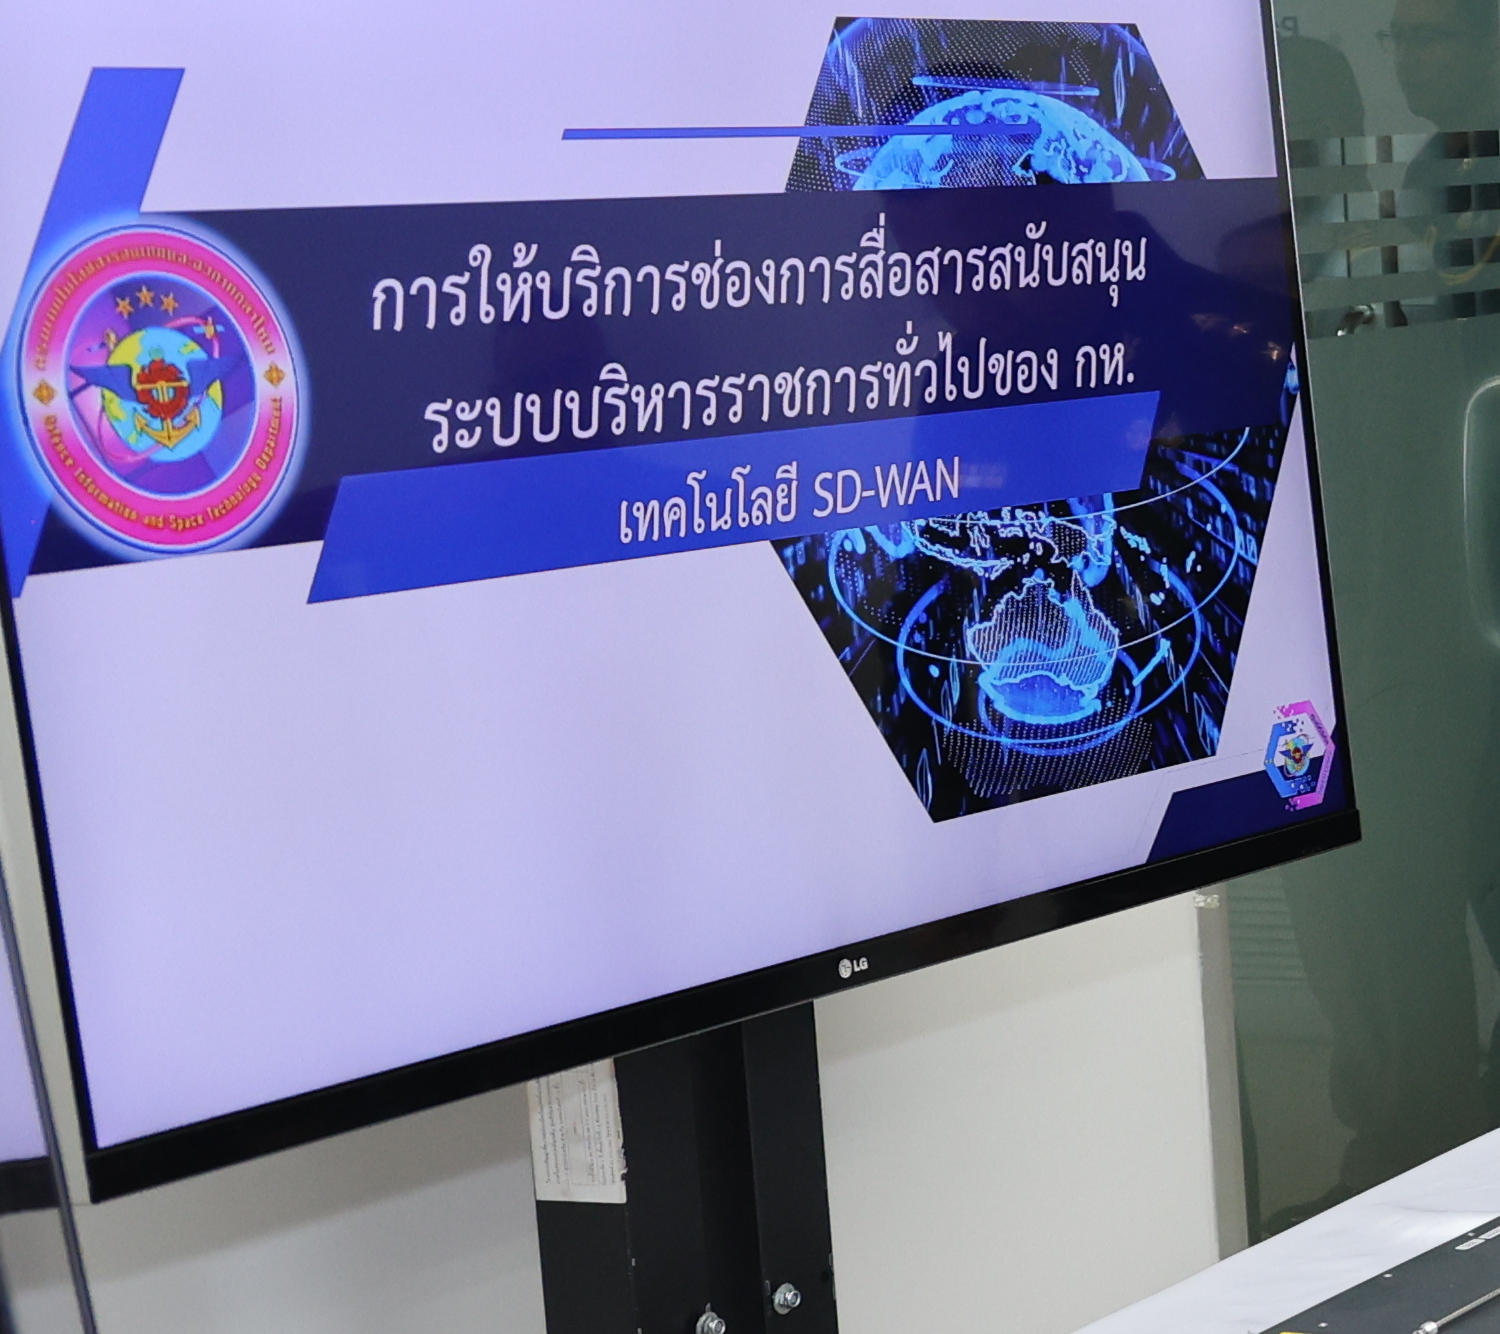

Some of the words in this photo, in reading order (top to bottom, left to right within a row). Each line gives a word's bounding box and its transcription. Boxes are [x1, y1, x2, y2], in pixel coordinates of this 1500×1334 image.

[370, 212, 1148, 333] การให้บริการช่องการสื่อสารสนับสนุน
[422, 321, 1060, 455] ระบบบริหารราชการทั่วไปของ
[1073, 343, 1137, 391] กห.
[619, 464, 801, 544] เทคโนโลยี
[812, 456, 961, 521] SD-WAN
